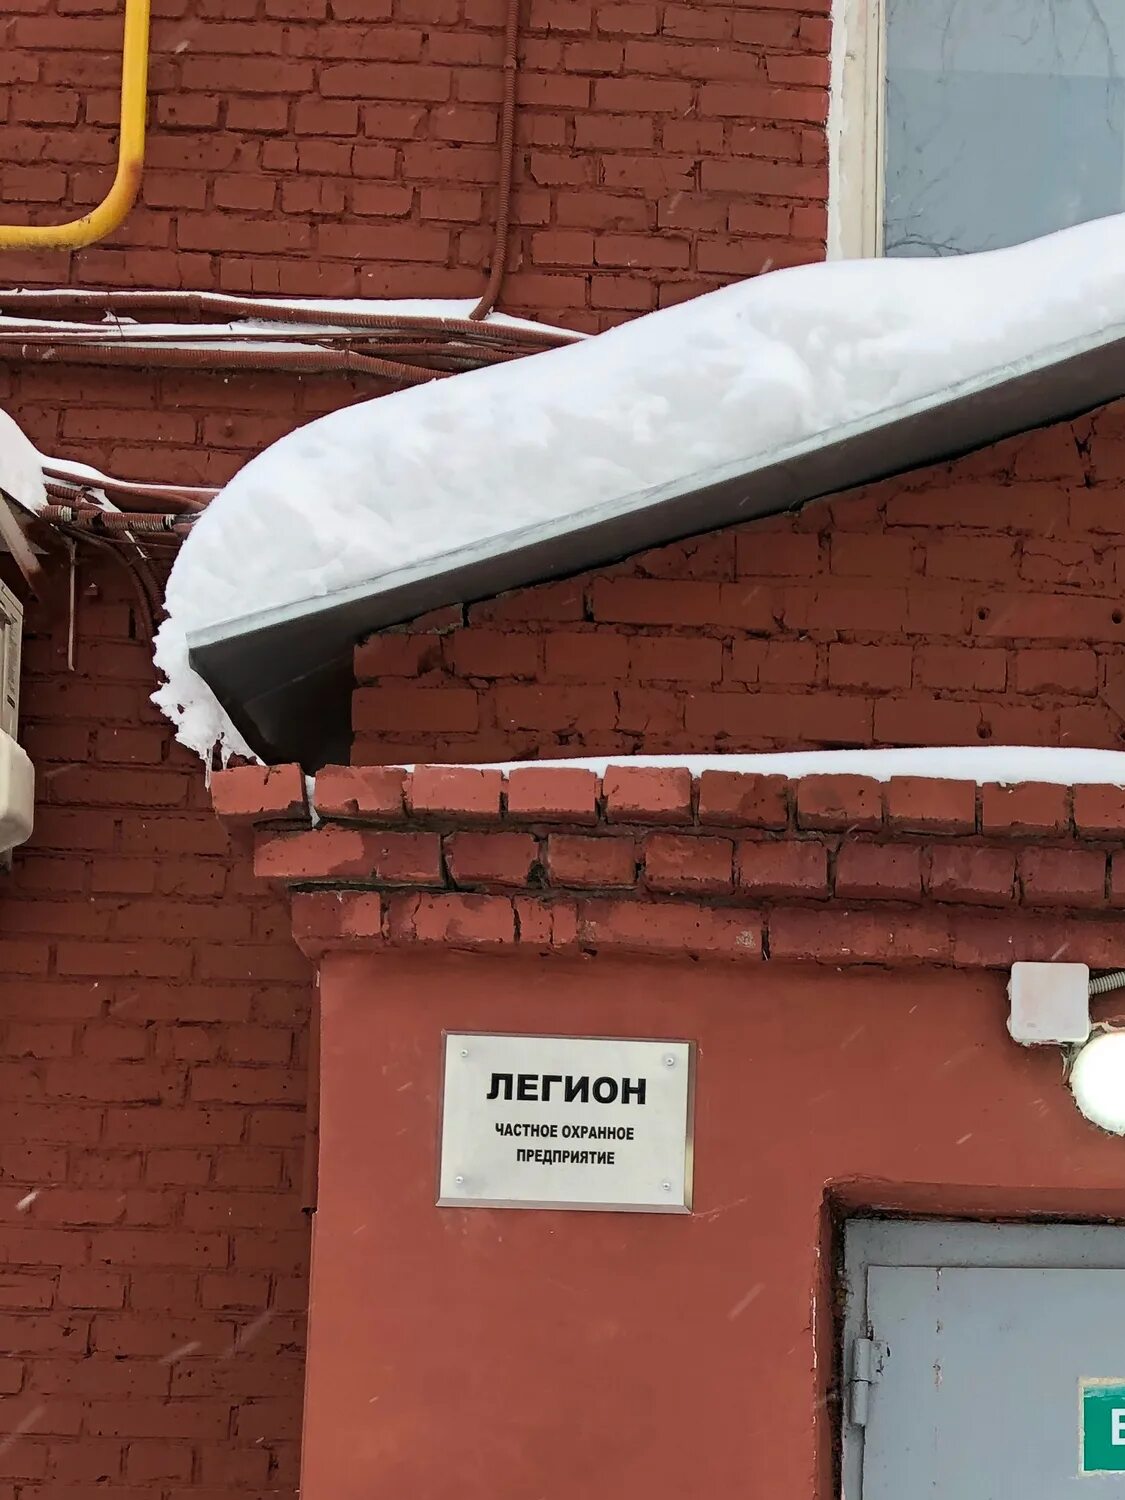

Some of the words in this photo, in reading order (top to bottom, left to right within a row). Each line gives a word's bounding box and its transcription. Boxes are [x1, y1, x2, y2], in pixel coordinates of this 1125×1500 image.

[487, 1073, 646, 1105] ЛЕГИОН
[495, 1123, 558, 1138] ЧАСТНОЕ
[562, 1125, 634, 1140] ОХРАННОЕ
[517, 1149, 615, 1165] ПРЕДПРИЯТИЕ
